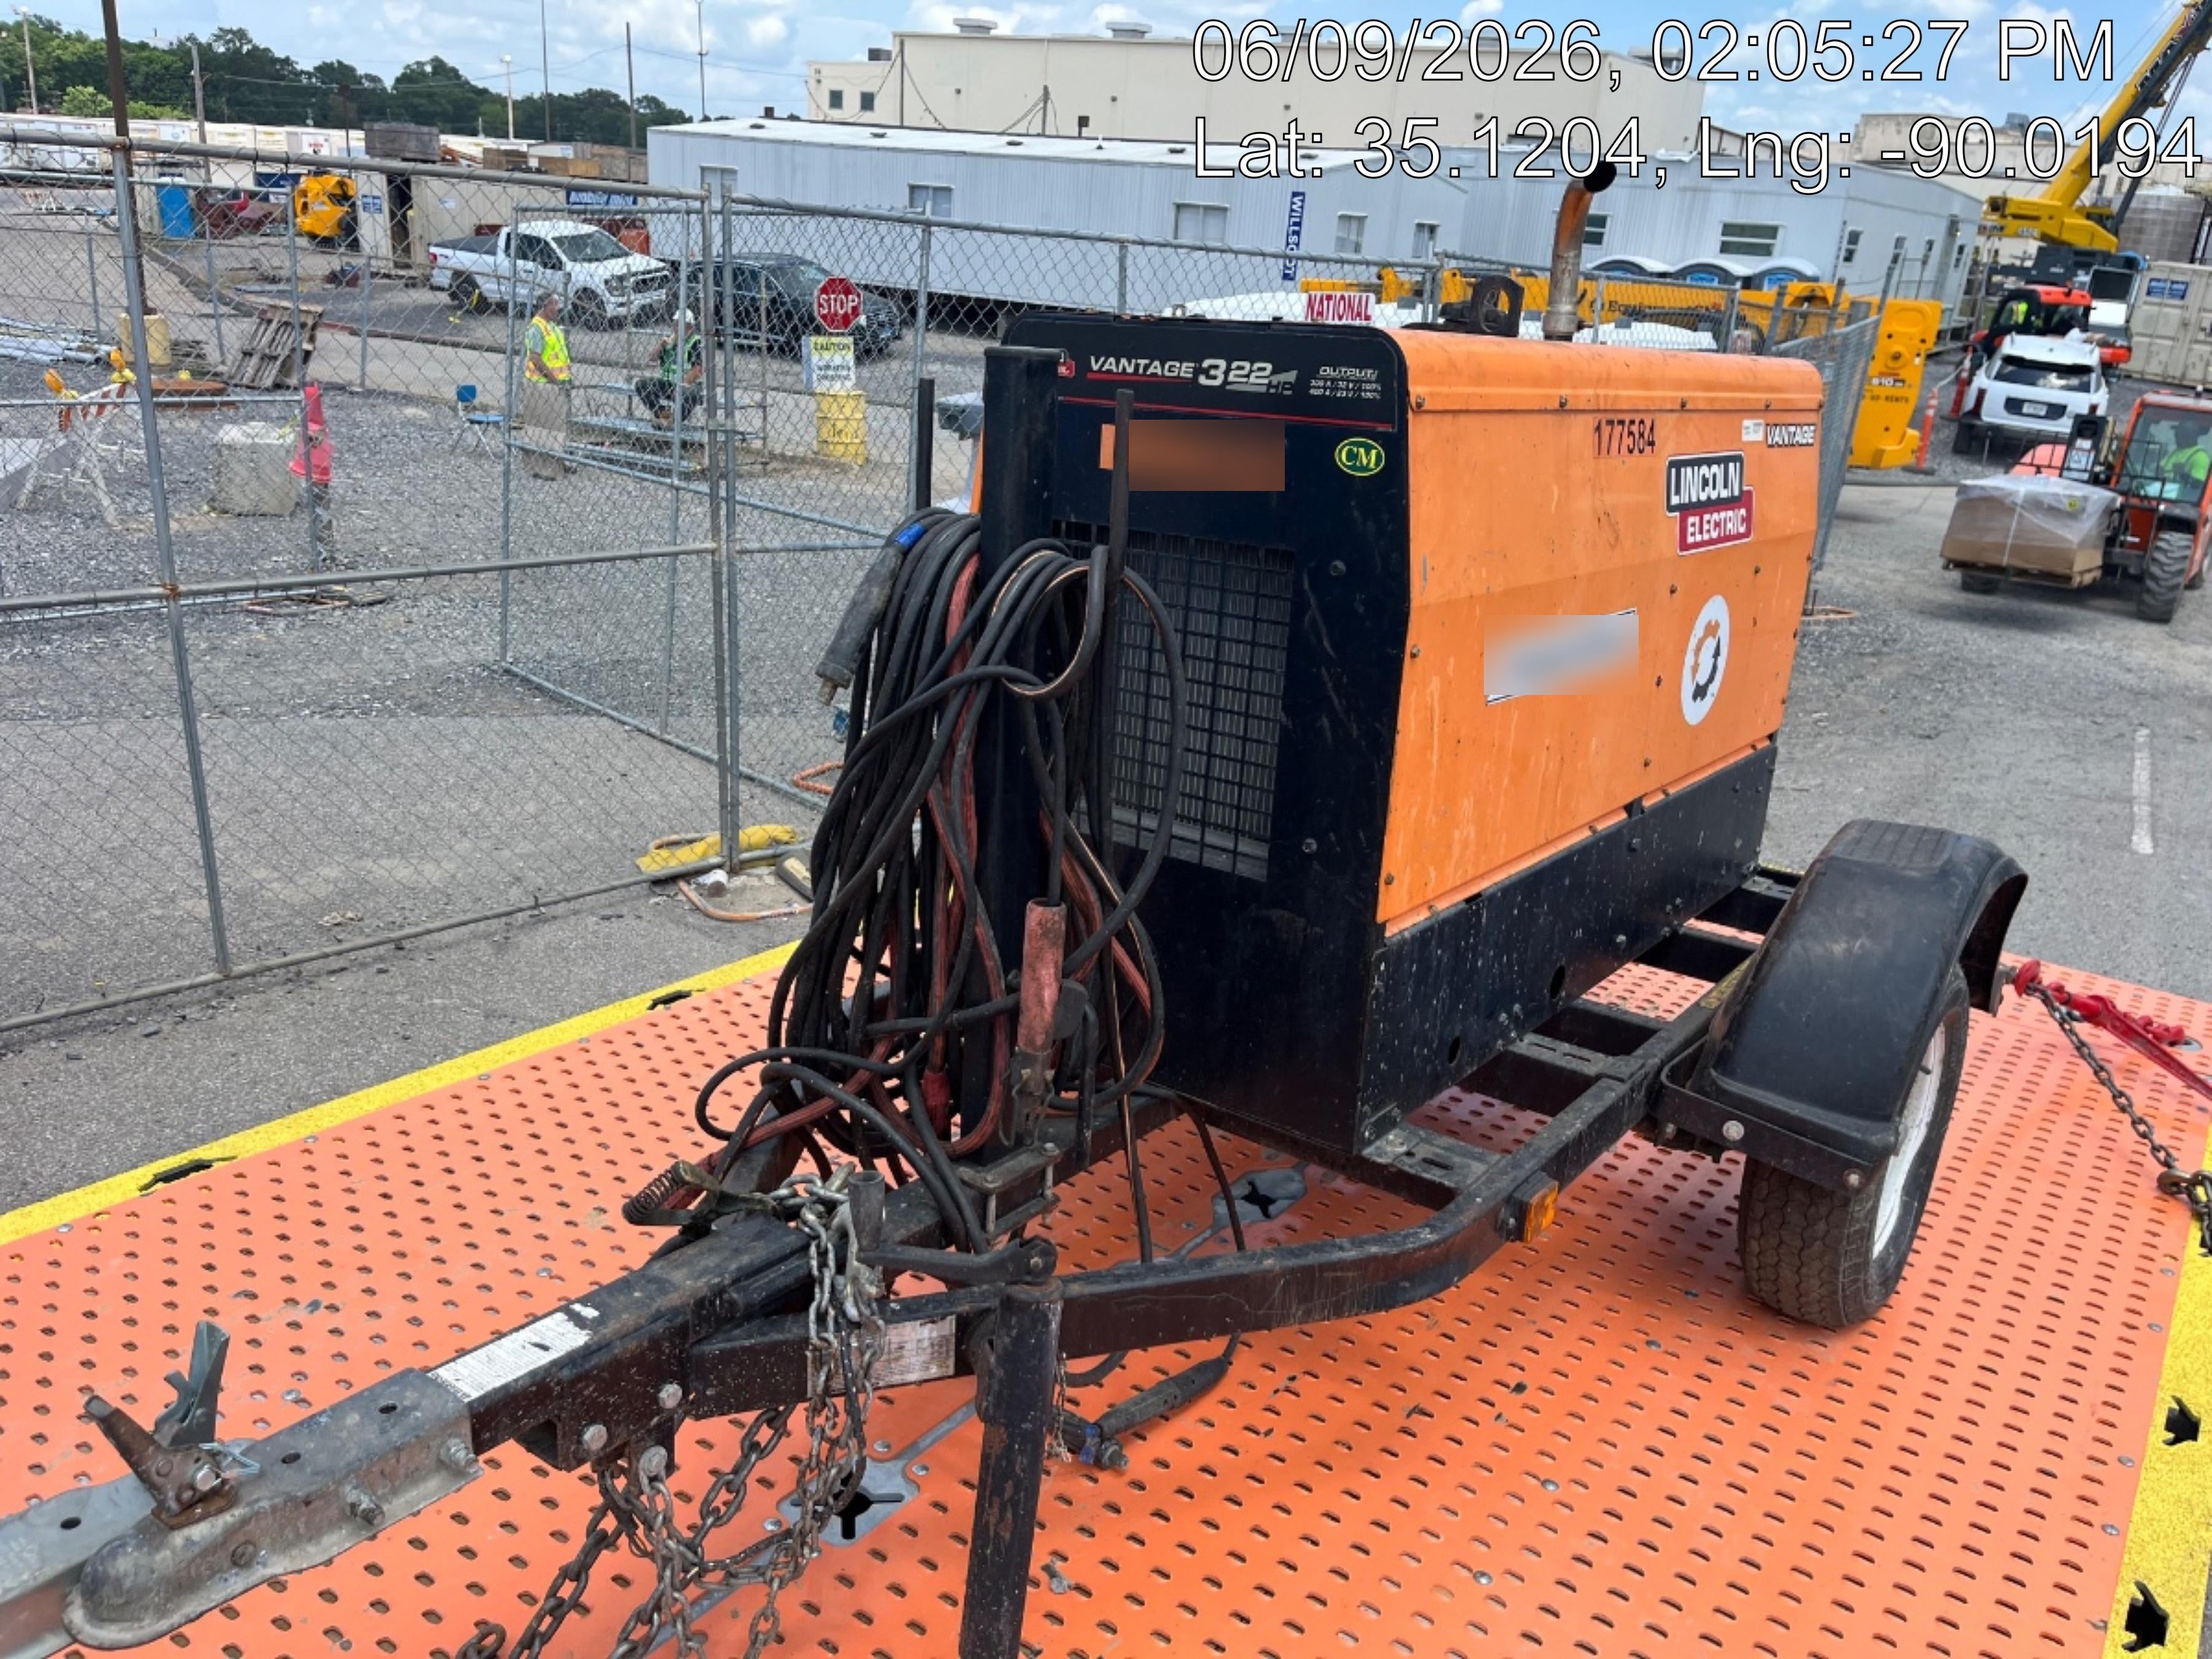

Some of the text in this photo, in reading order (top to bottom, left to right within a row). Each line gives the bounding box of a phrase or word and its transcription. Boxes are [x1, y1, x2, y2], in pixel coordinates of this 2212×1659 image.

[819, 294, 858, 315] STOP
[1305, 293, 1372, 322] NATIONAL
[1090, 355, 1196, 378] VANTAGE
[1198, 358, 1273, 386] 322
[1594, 418, 1656, 456] 177584
[1767, 424, 1816, 447] VANTAGE
[1341, 445, 1378, 469] CM
[1670, 462, 1741, 506] LINCOLN
[1687, 508, 1746, 544] ELECTRIC
